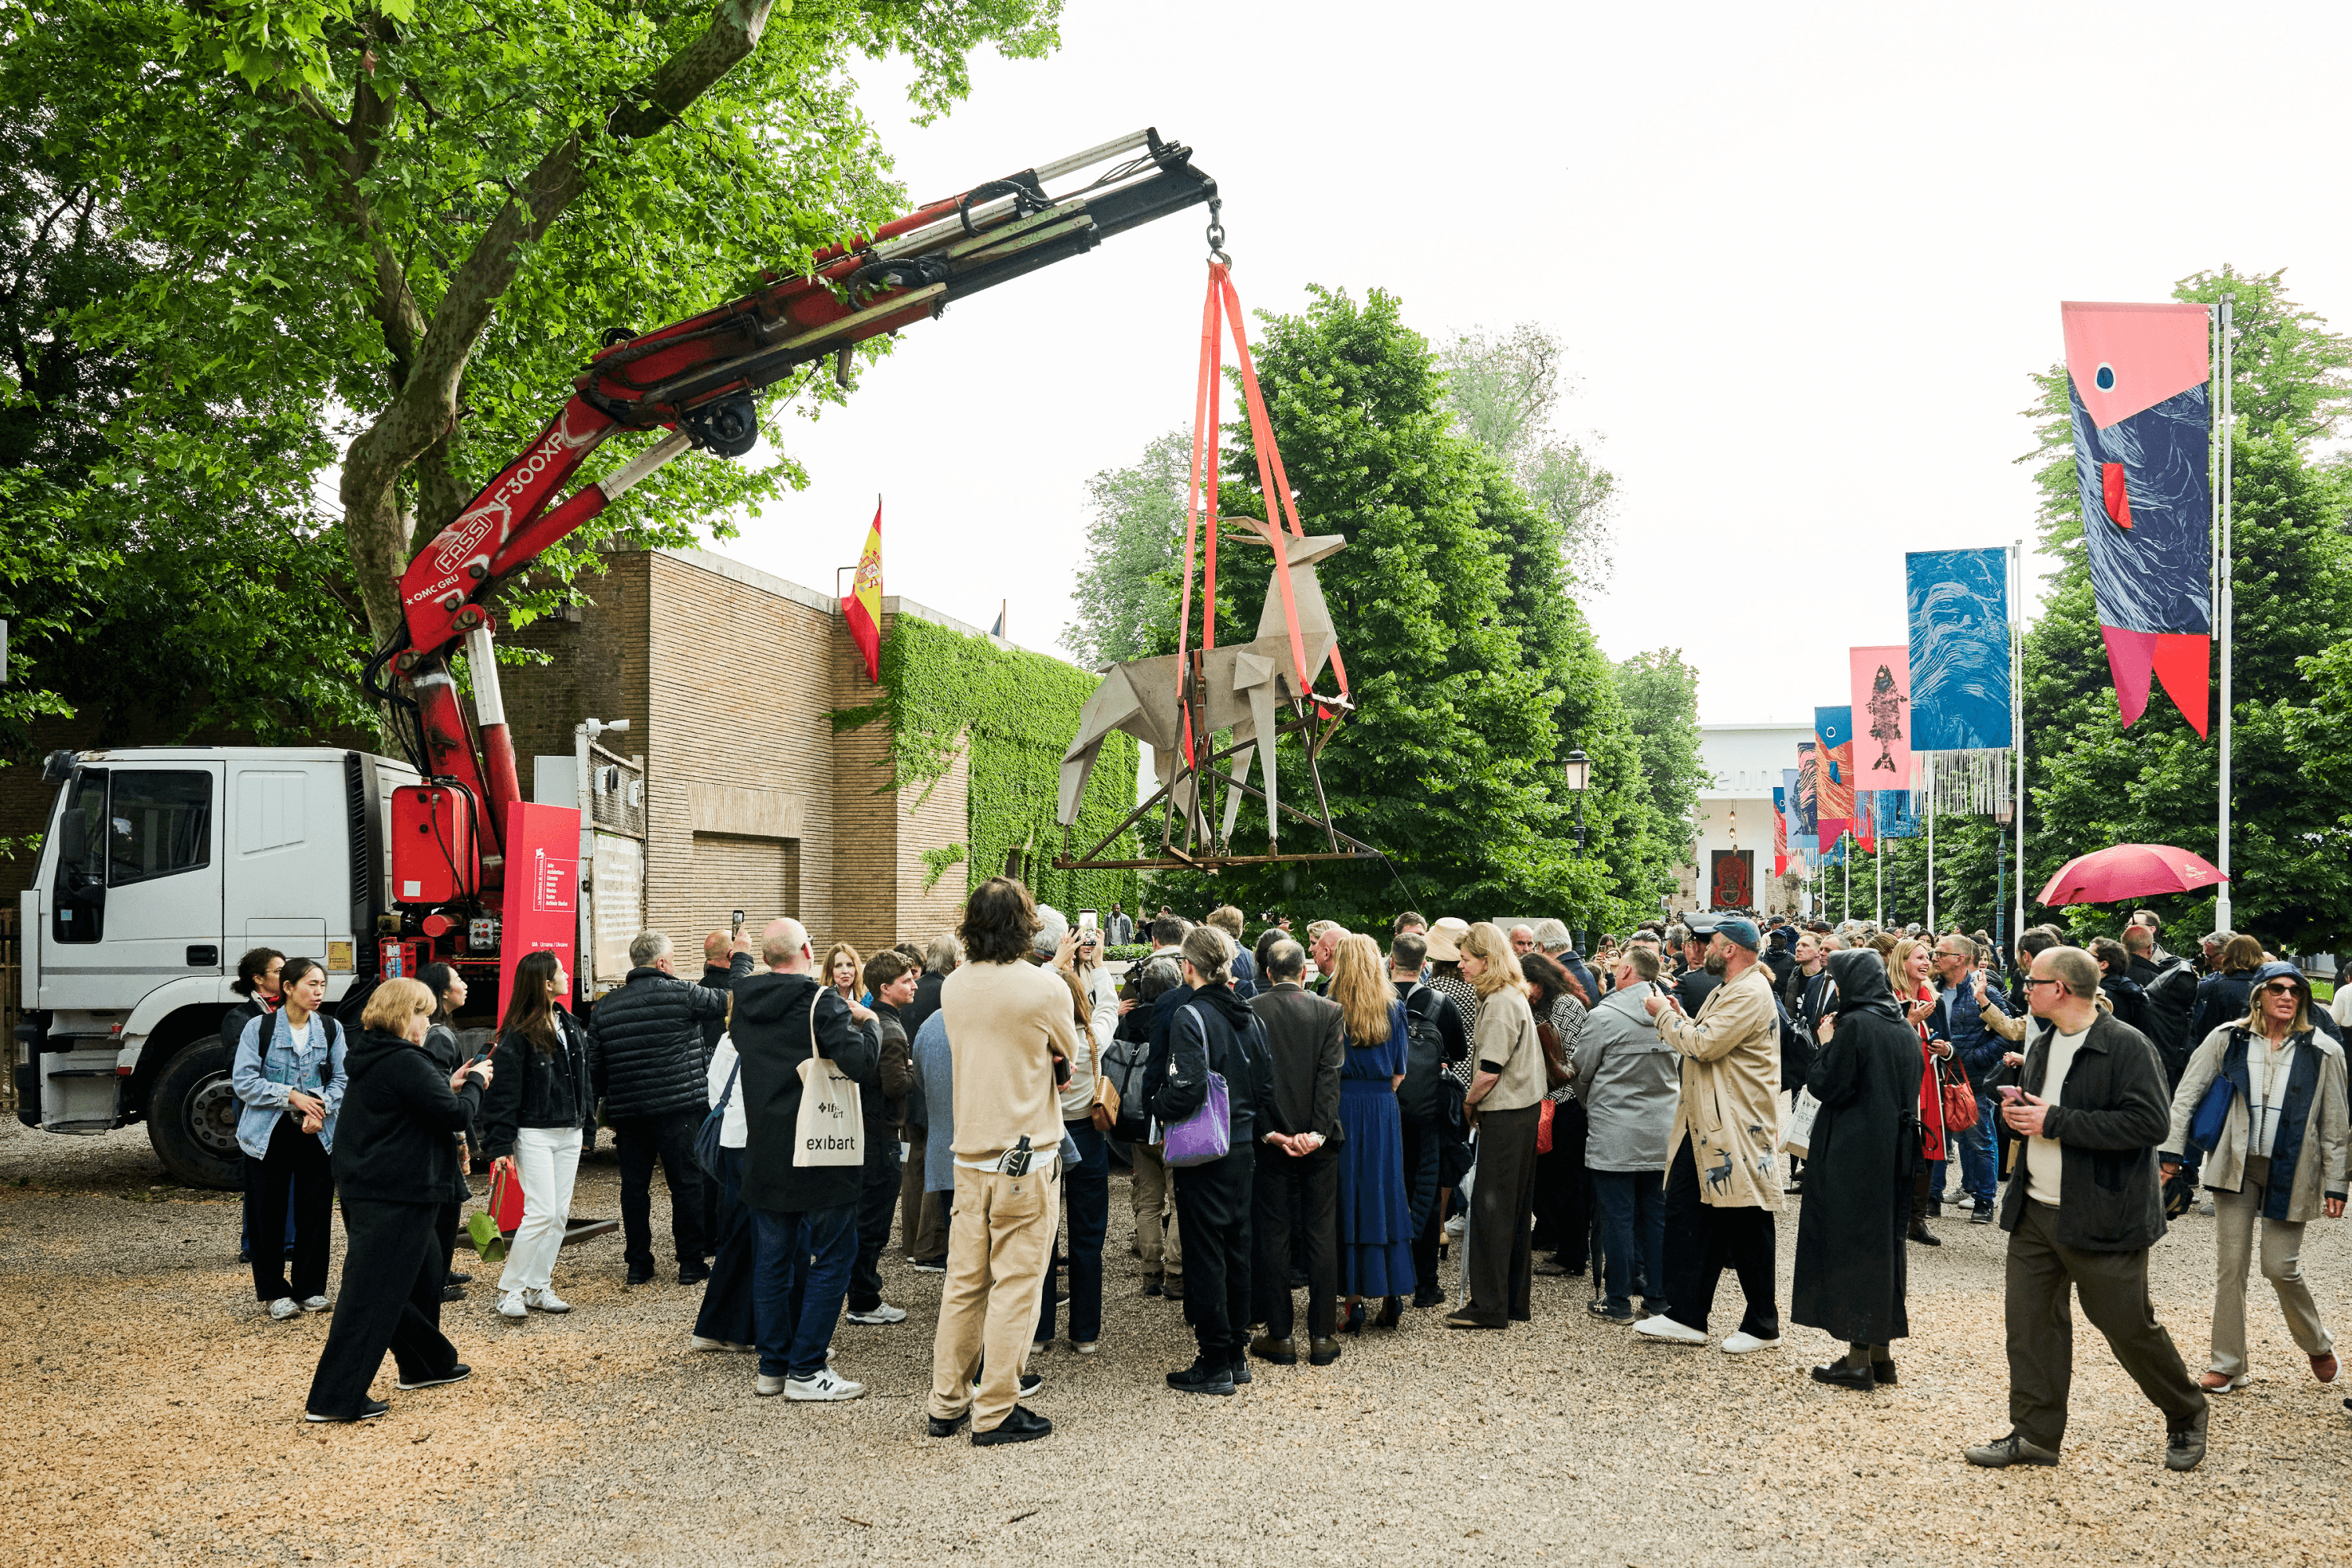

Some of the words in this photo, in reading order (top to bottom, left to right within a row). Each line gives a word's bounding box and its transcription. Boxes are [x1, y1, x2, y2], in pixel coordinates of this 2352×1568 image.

[494, 431, 564, 507] F300XP
[439, 517, 489, 570] FASSI
[414, 586, 438, 602] OMC
[437, 574, 459, 590] GRU
[807, 1134, 855, 1151] exibart
